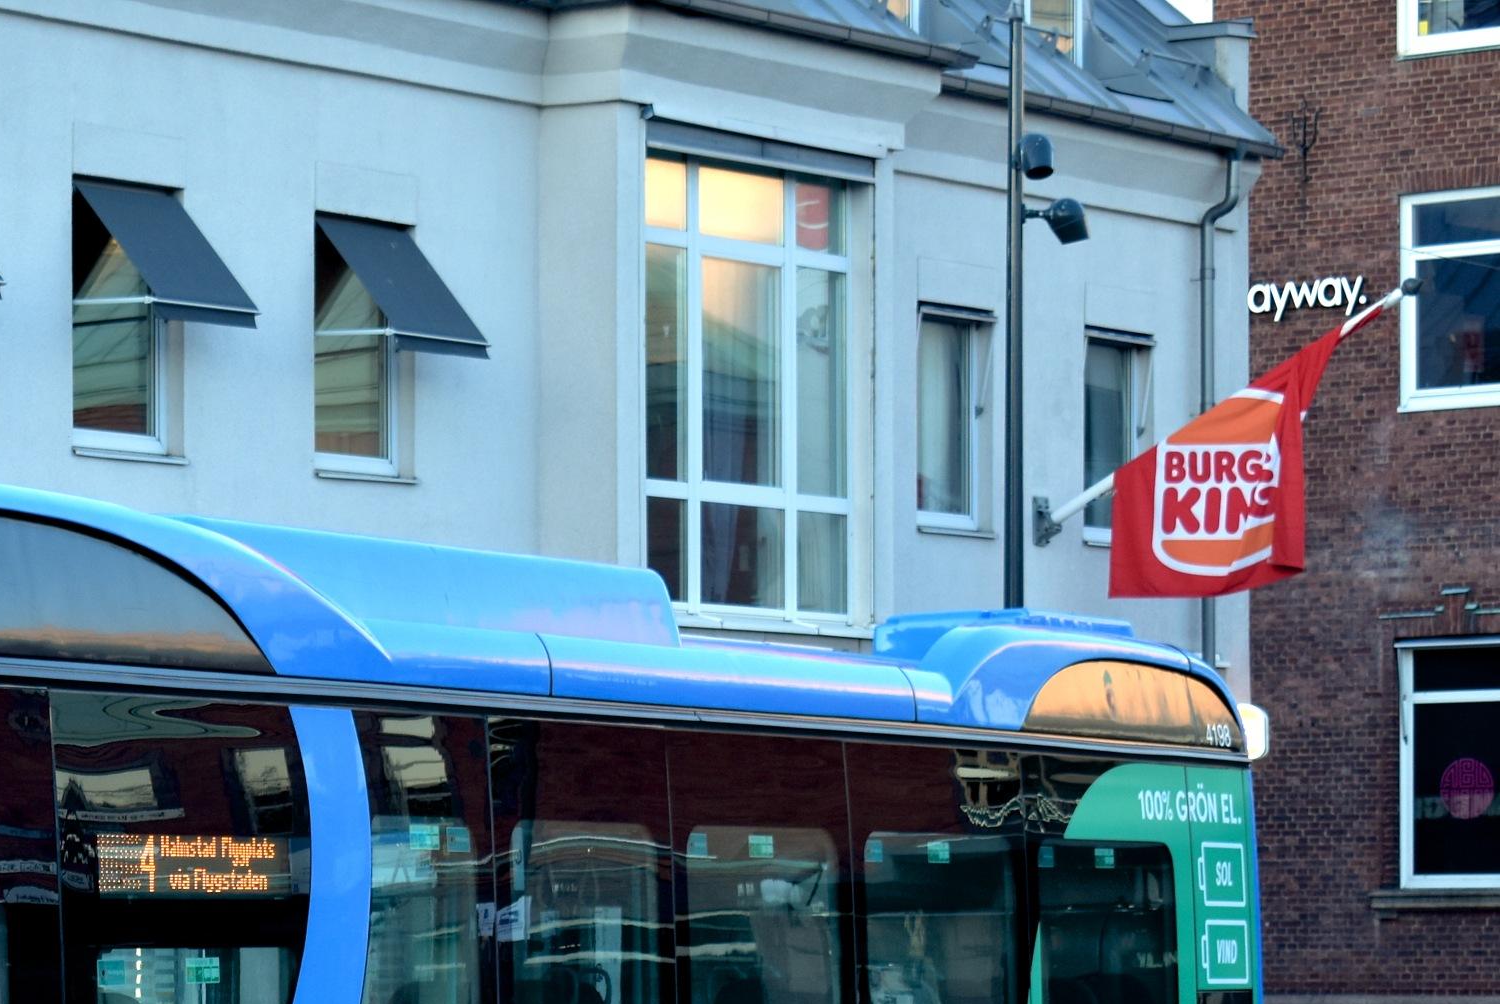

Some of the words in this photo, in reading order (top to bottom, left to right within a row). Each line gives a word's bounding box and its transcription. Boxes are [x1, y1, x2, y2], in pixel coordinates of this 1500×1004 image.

[1247, 275, 1367, 322] ayway.
[1164, 450, 1273, 484] BURG
[1206, 723, 1232, 747] 4198
[1138, 789, 1174, 822] 100%
[1175, 783, 1219, 824] GRÖN
[1221, 792, 1242, 824] EL.
[139, 835, 156, 893] 4
[160, 835, 217, 858] Halmstad
[221, 836, 276, 867] Flygplats
[169, 868, 190, 890] via
[194, 868, 268, 893] Flygstaden
[1215, 861, 1233, 886] SOL
[1216, 939, 1238, 965] VIND
